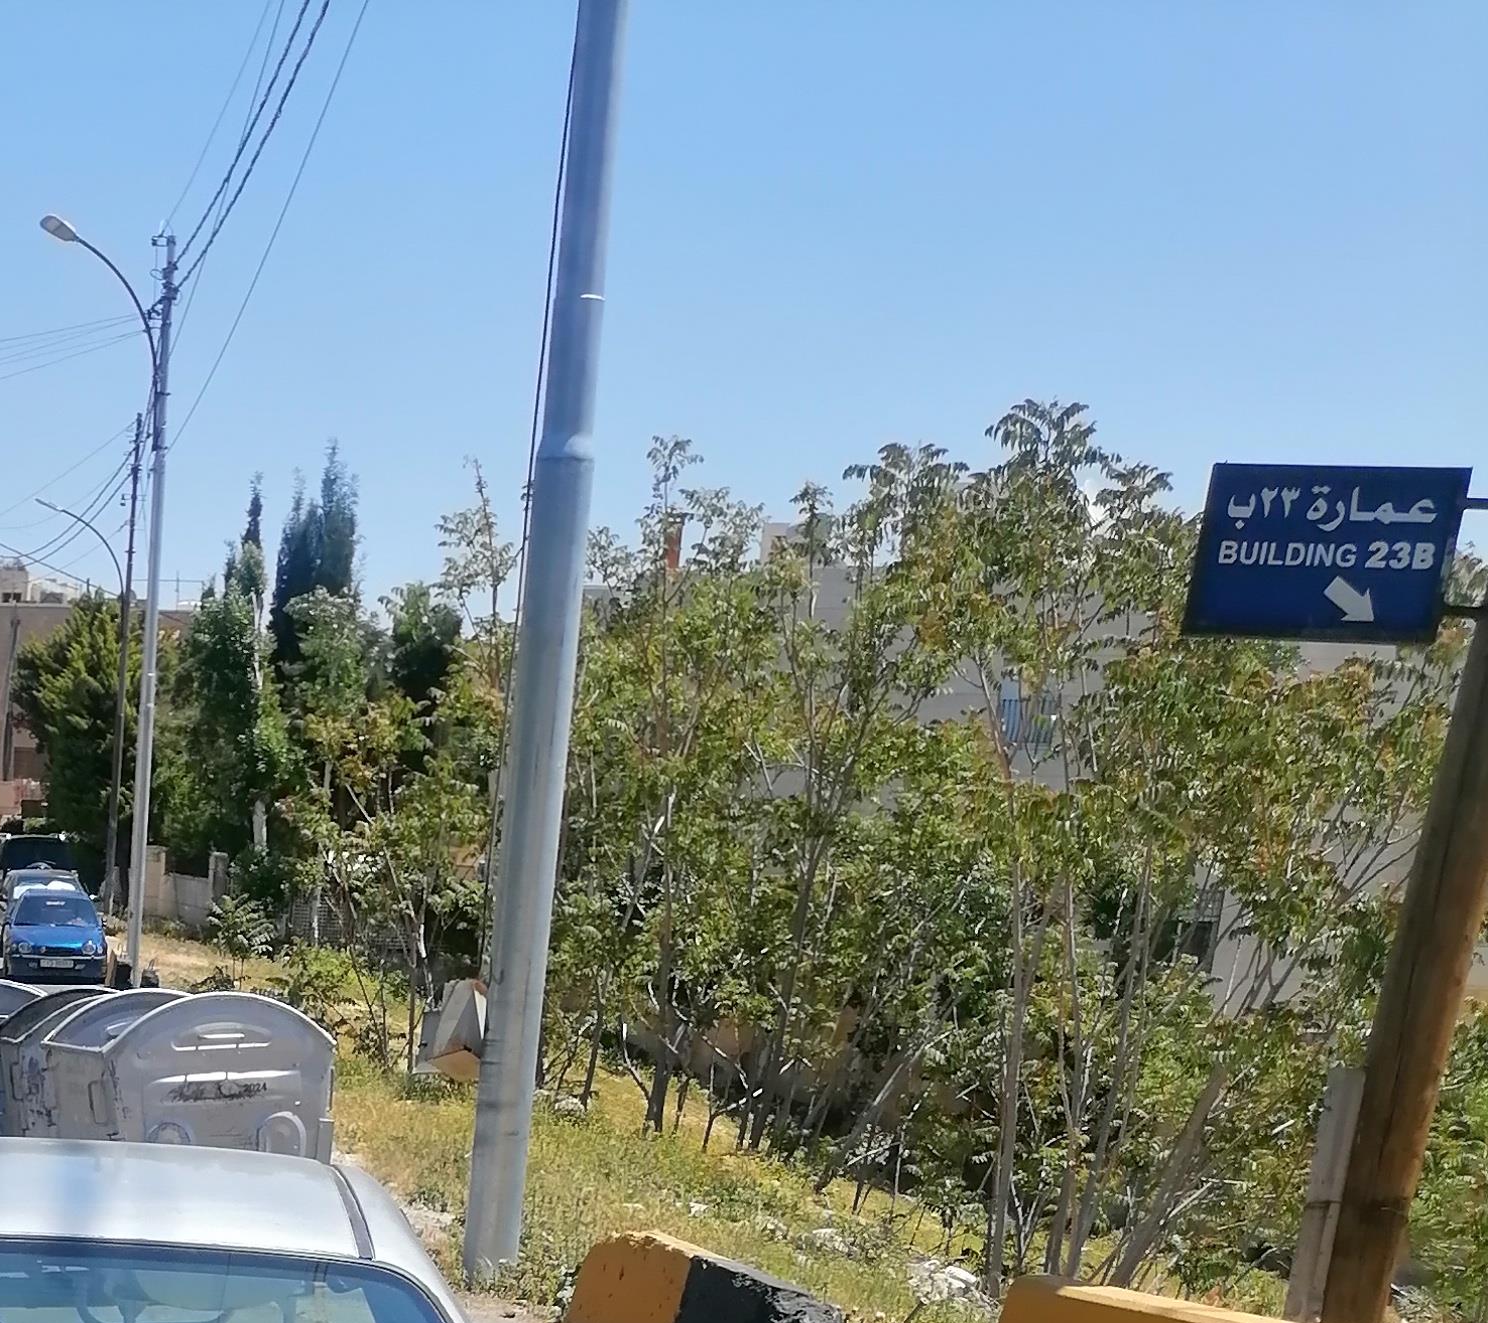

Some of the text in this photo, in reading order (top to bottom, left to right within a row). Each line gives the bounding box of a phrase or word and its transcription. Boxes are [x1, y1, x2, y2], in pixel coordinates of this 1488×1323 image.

[1307, 485, 1438, 532] عمارة
[1218, 540, 1436, 570] BUILDING 23B
